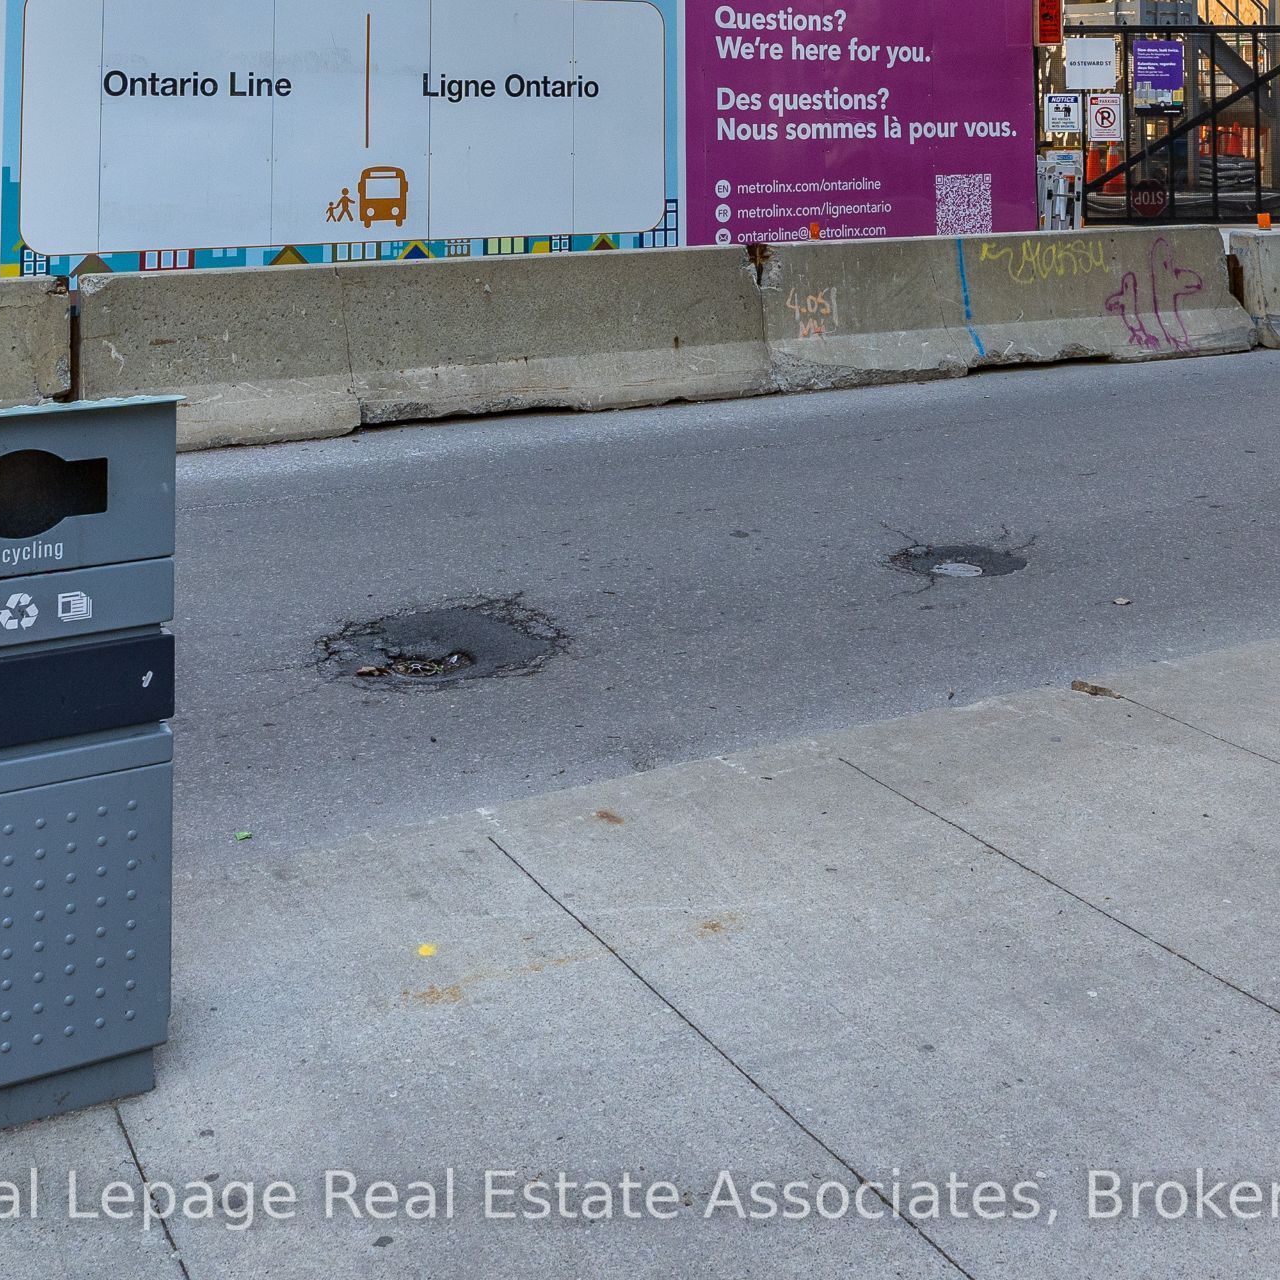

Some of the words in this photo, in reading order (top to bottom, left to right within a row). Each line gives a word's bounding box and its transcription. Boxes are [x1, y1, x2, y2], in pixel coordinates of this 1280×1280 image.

[714, 5, 847, 33] Questions?
[715, 36, 784, 61] We're
[791, 37, 842, 62] here
[848, 37, 880, 62] for
[886, 44, 932, 69] you.
[103, 69, 218, 98] Ontario
[229, 70, 292, 98] Line
[422, 72, 496, 104] Ligne
[504, 72, 600, 99] Ontario
[717, 87, 762, 111] Des
[768, 87, 890, 117] questions?
[717, 117, 779, 141] Nous
[785, 120, 877, 140] sommes
[884, 116, 902, 139] là
[909, 119, 958, 145] pour
[964, 119, 1017, 138] vous.
[717, 183, 730, 194] EN
[737, 178, 881, 195] metrolinx.com/ontarioline
[1134, 191, 1164, 205] STOP
[718, 208, 729, 219] FR
[737, 201, 892, 221] metrolinx.com/ligneontario
[737, 224, 886, 243] ontarioline@etrolinx.com
